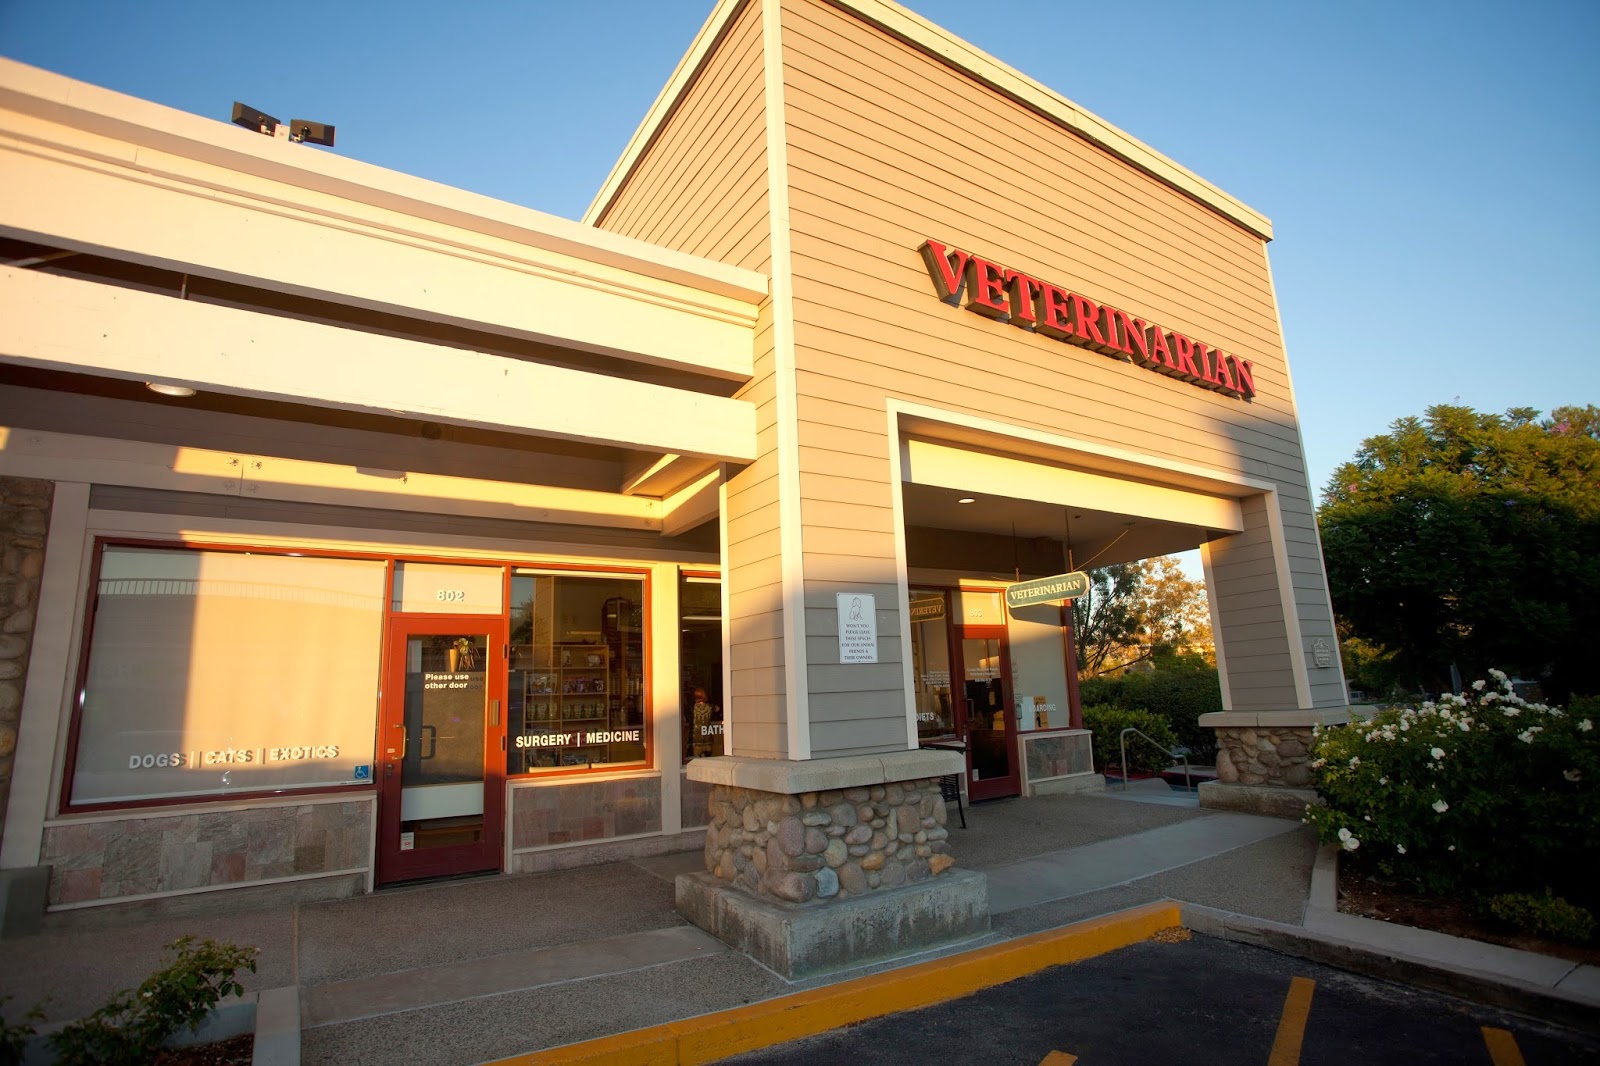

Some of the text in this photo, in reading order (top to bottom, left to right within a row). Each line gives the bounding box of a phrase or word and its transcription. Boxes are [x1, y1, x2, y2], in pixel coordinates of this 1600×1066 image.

[918, 239, 1255, 401] VETERINARIAN
[437, 590, 464, 602] 802
[1010, 580, 1081, 600] VETERINARIAN
[516, 734, 571, 748] SURGERY
[586, 730, 640, 744] MEDICINE
[128, 752, 180, 769] DOGS
[204, 749, 248, 764] CATS
[269, 745, 338, 761] EXOTICS
